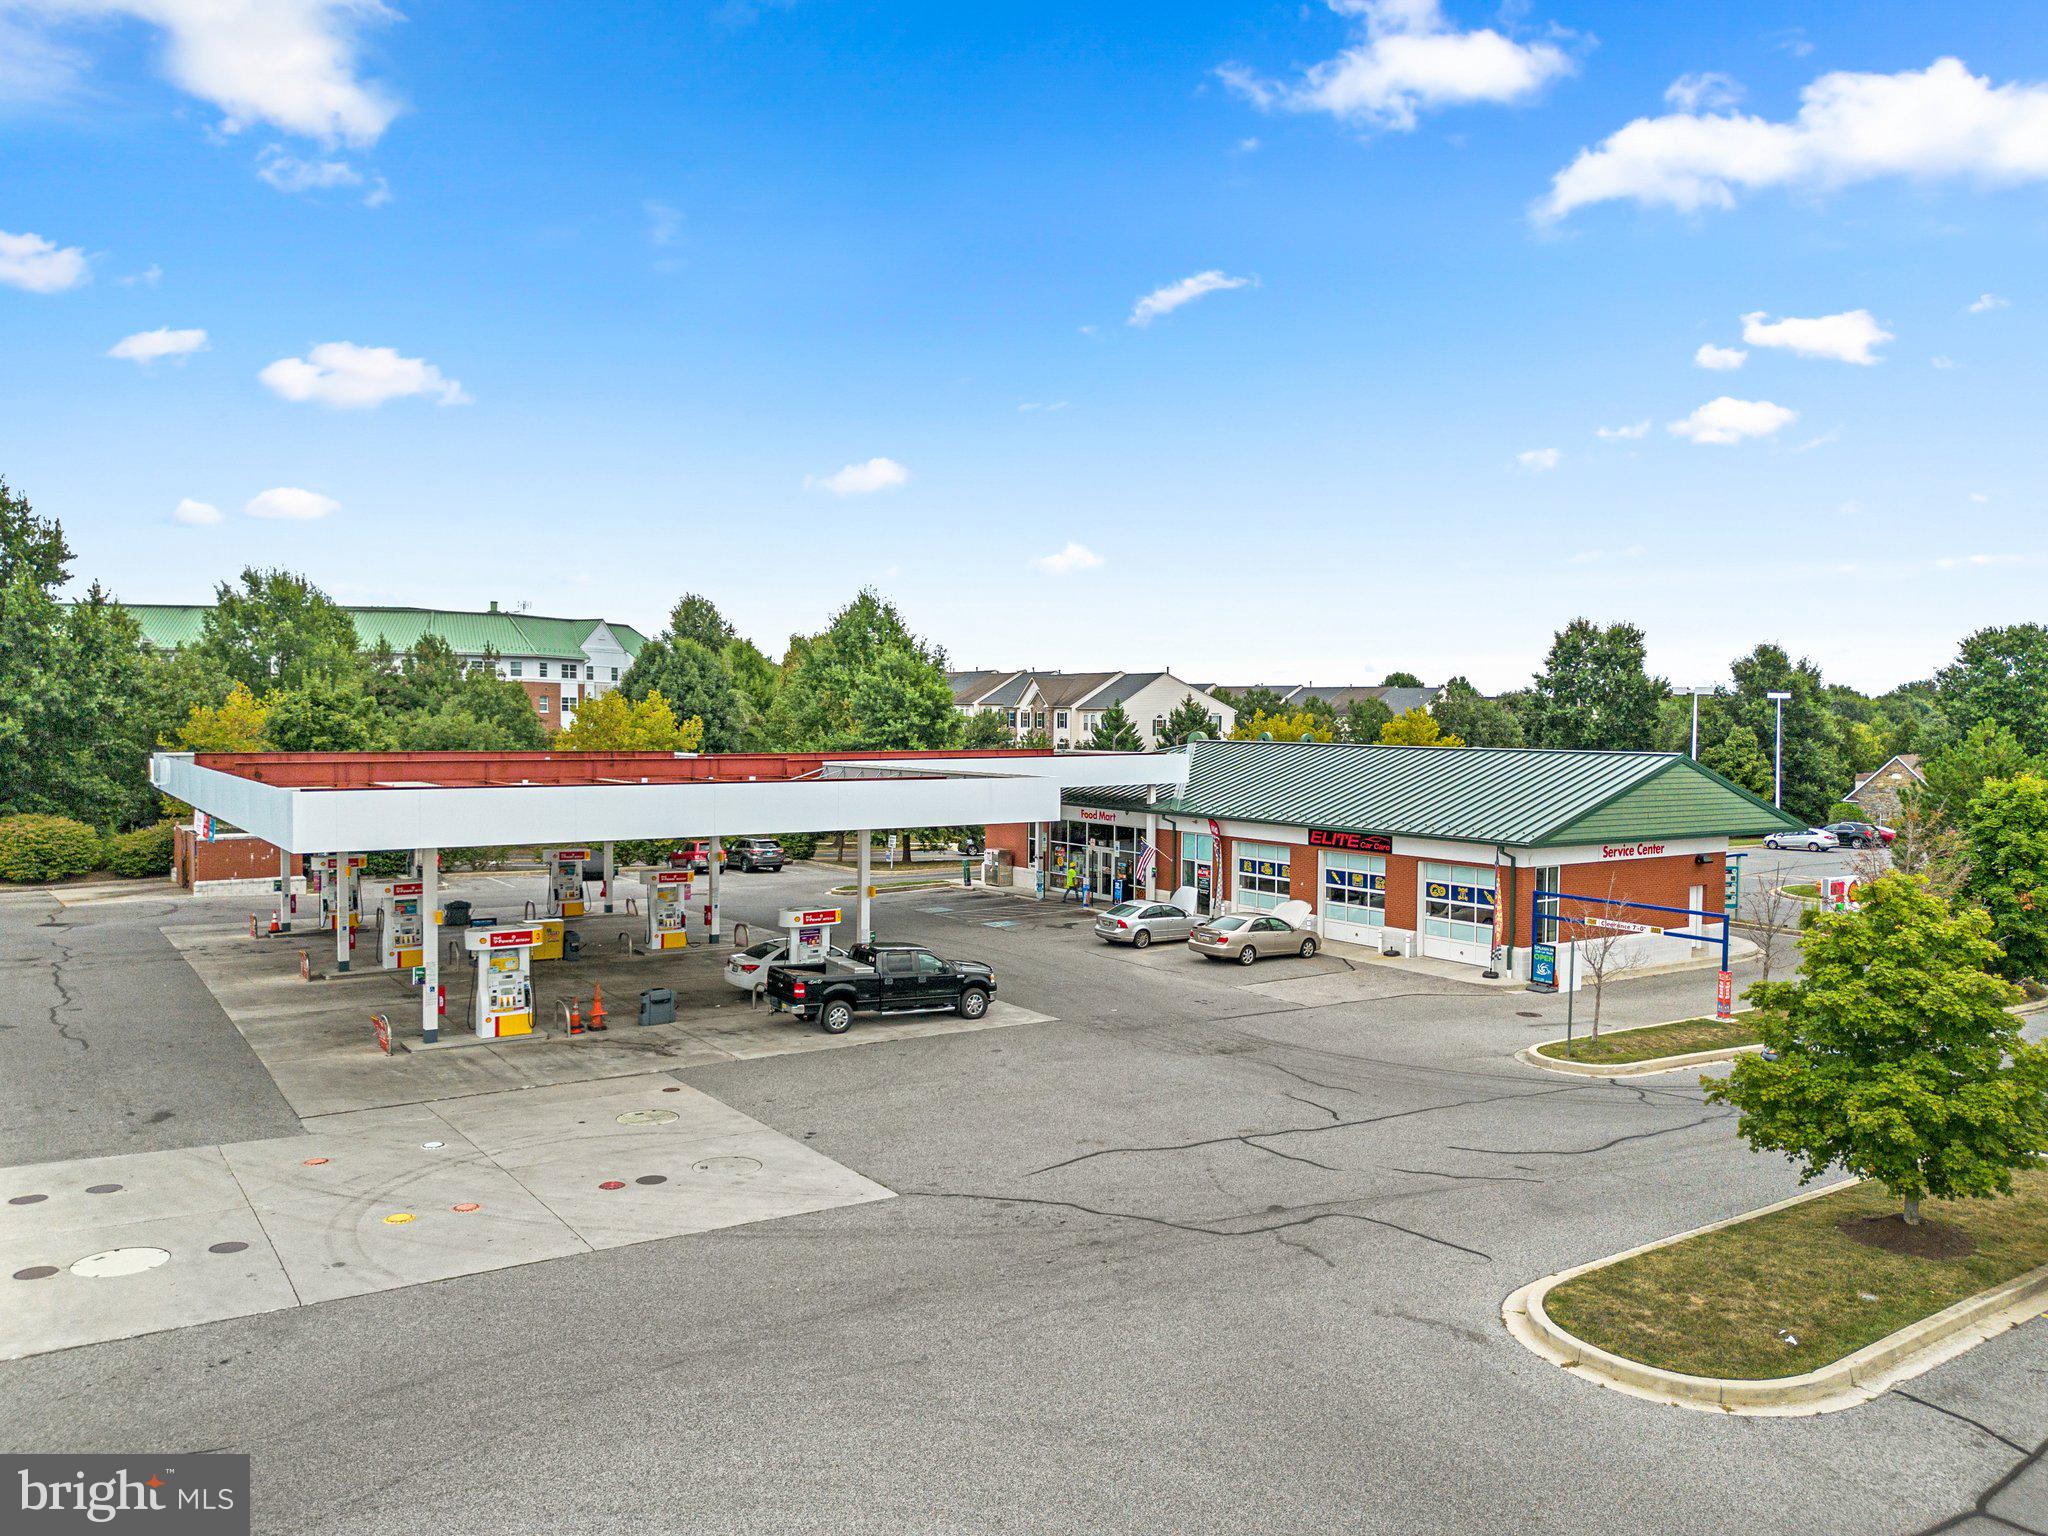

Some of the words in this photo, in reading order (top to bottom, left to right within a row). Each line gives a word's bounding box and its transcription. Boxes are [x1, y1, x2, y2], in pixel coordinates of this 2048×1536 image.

[1080, 809, 1098, 820] Food
[1099, 811, 1116, 822] Mart
[1310, 830, 1360, 848] ELITE
[1360, 841, 1373, 849] Car
[1374, 843, 1391, 851] Care
[1602, 844, 1635, 858] Service
[1637, 843, 1665, 856] Center
[1533, 953, 1554, 963] OPEN
